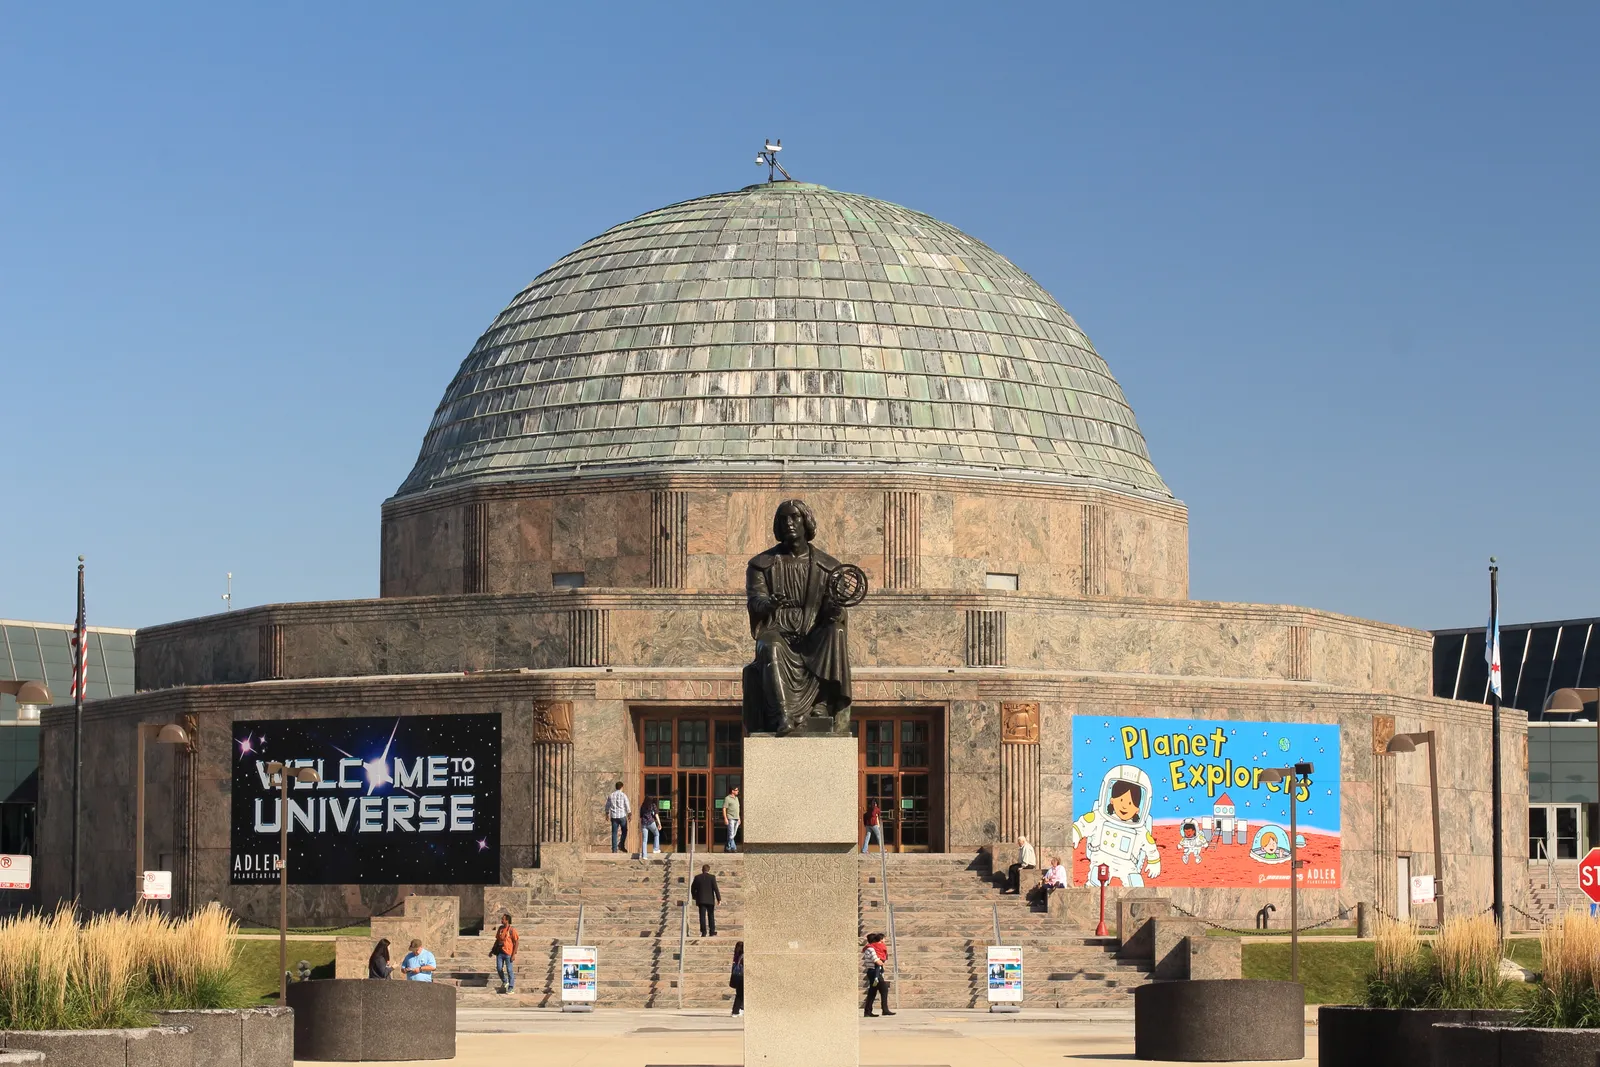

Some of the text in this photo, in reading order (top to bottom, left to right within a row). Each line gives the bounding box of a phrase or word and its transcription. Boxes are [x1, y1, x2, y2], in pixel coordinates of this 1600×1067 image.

[616, 681, 956, 698] THE ADLE TARIUM
[1120, 725, 1228, 760] Planet
[450, 757, 475, 773] TO
[451, 775, 474, 787] THE
[254, 794, 475, 833] UNIVERSE
[1307, 869, 1336, 880] ADLER
